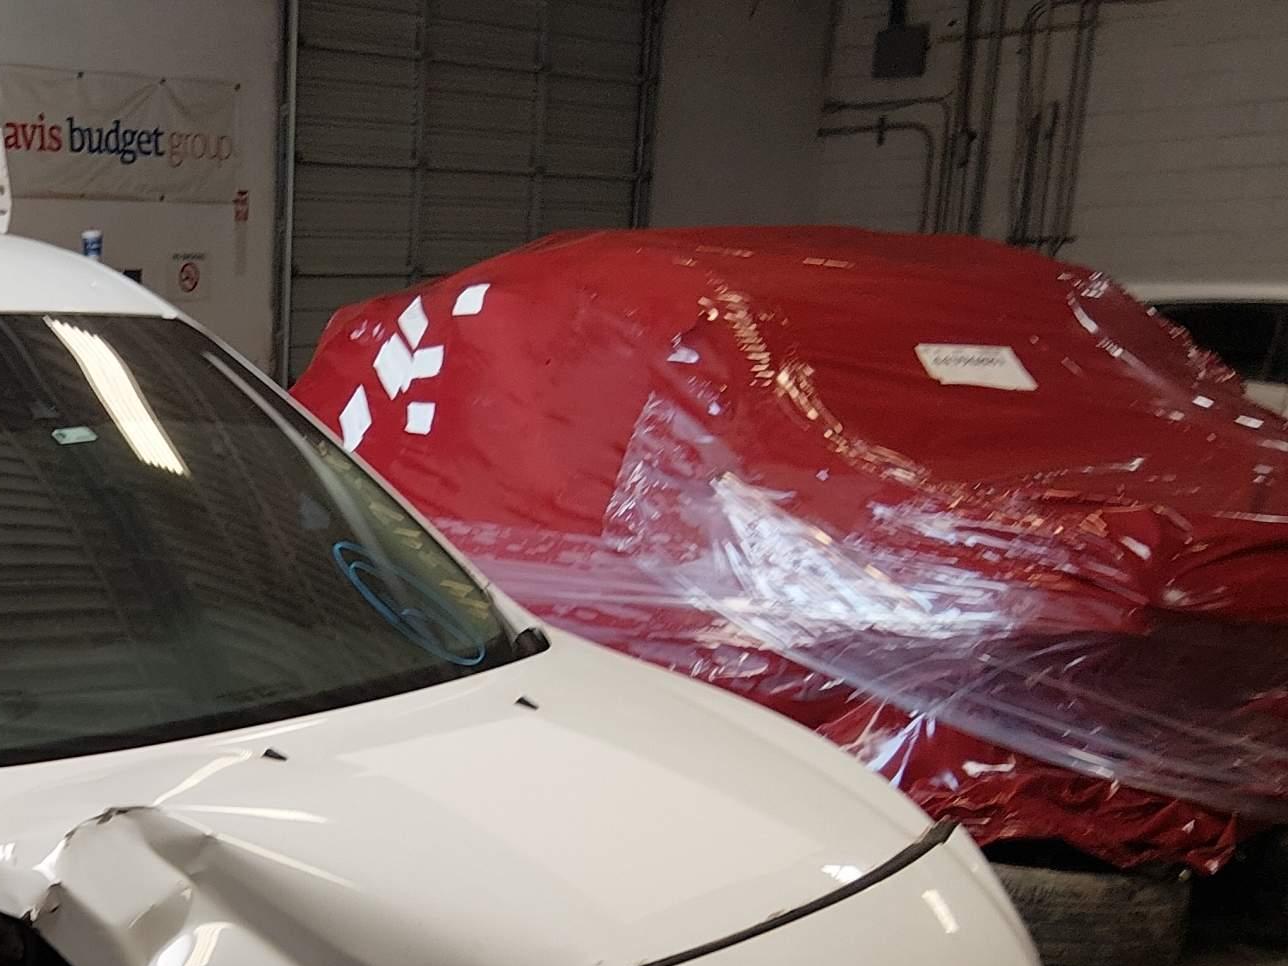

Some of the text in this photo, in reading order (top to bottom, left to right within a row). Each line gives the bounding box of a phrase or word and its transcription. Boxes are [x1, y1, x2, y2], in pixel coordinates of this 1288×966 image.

[4, 112, 233, 168] avis budget group
